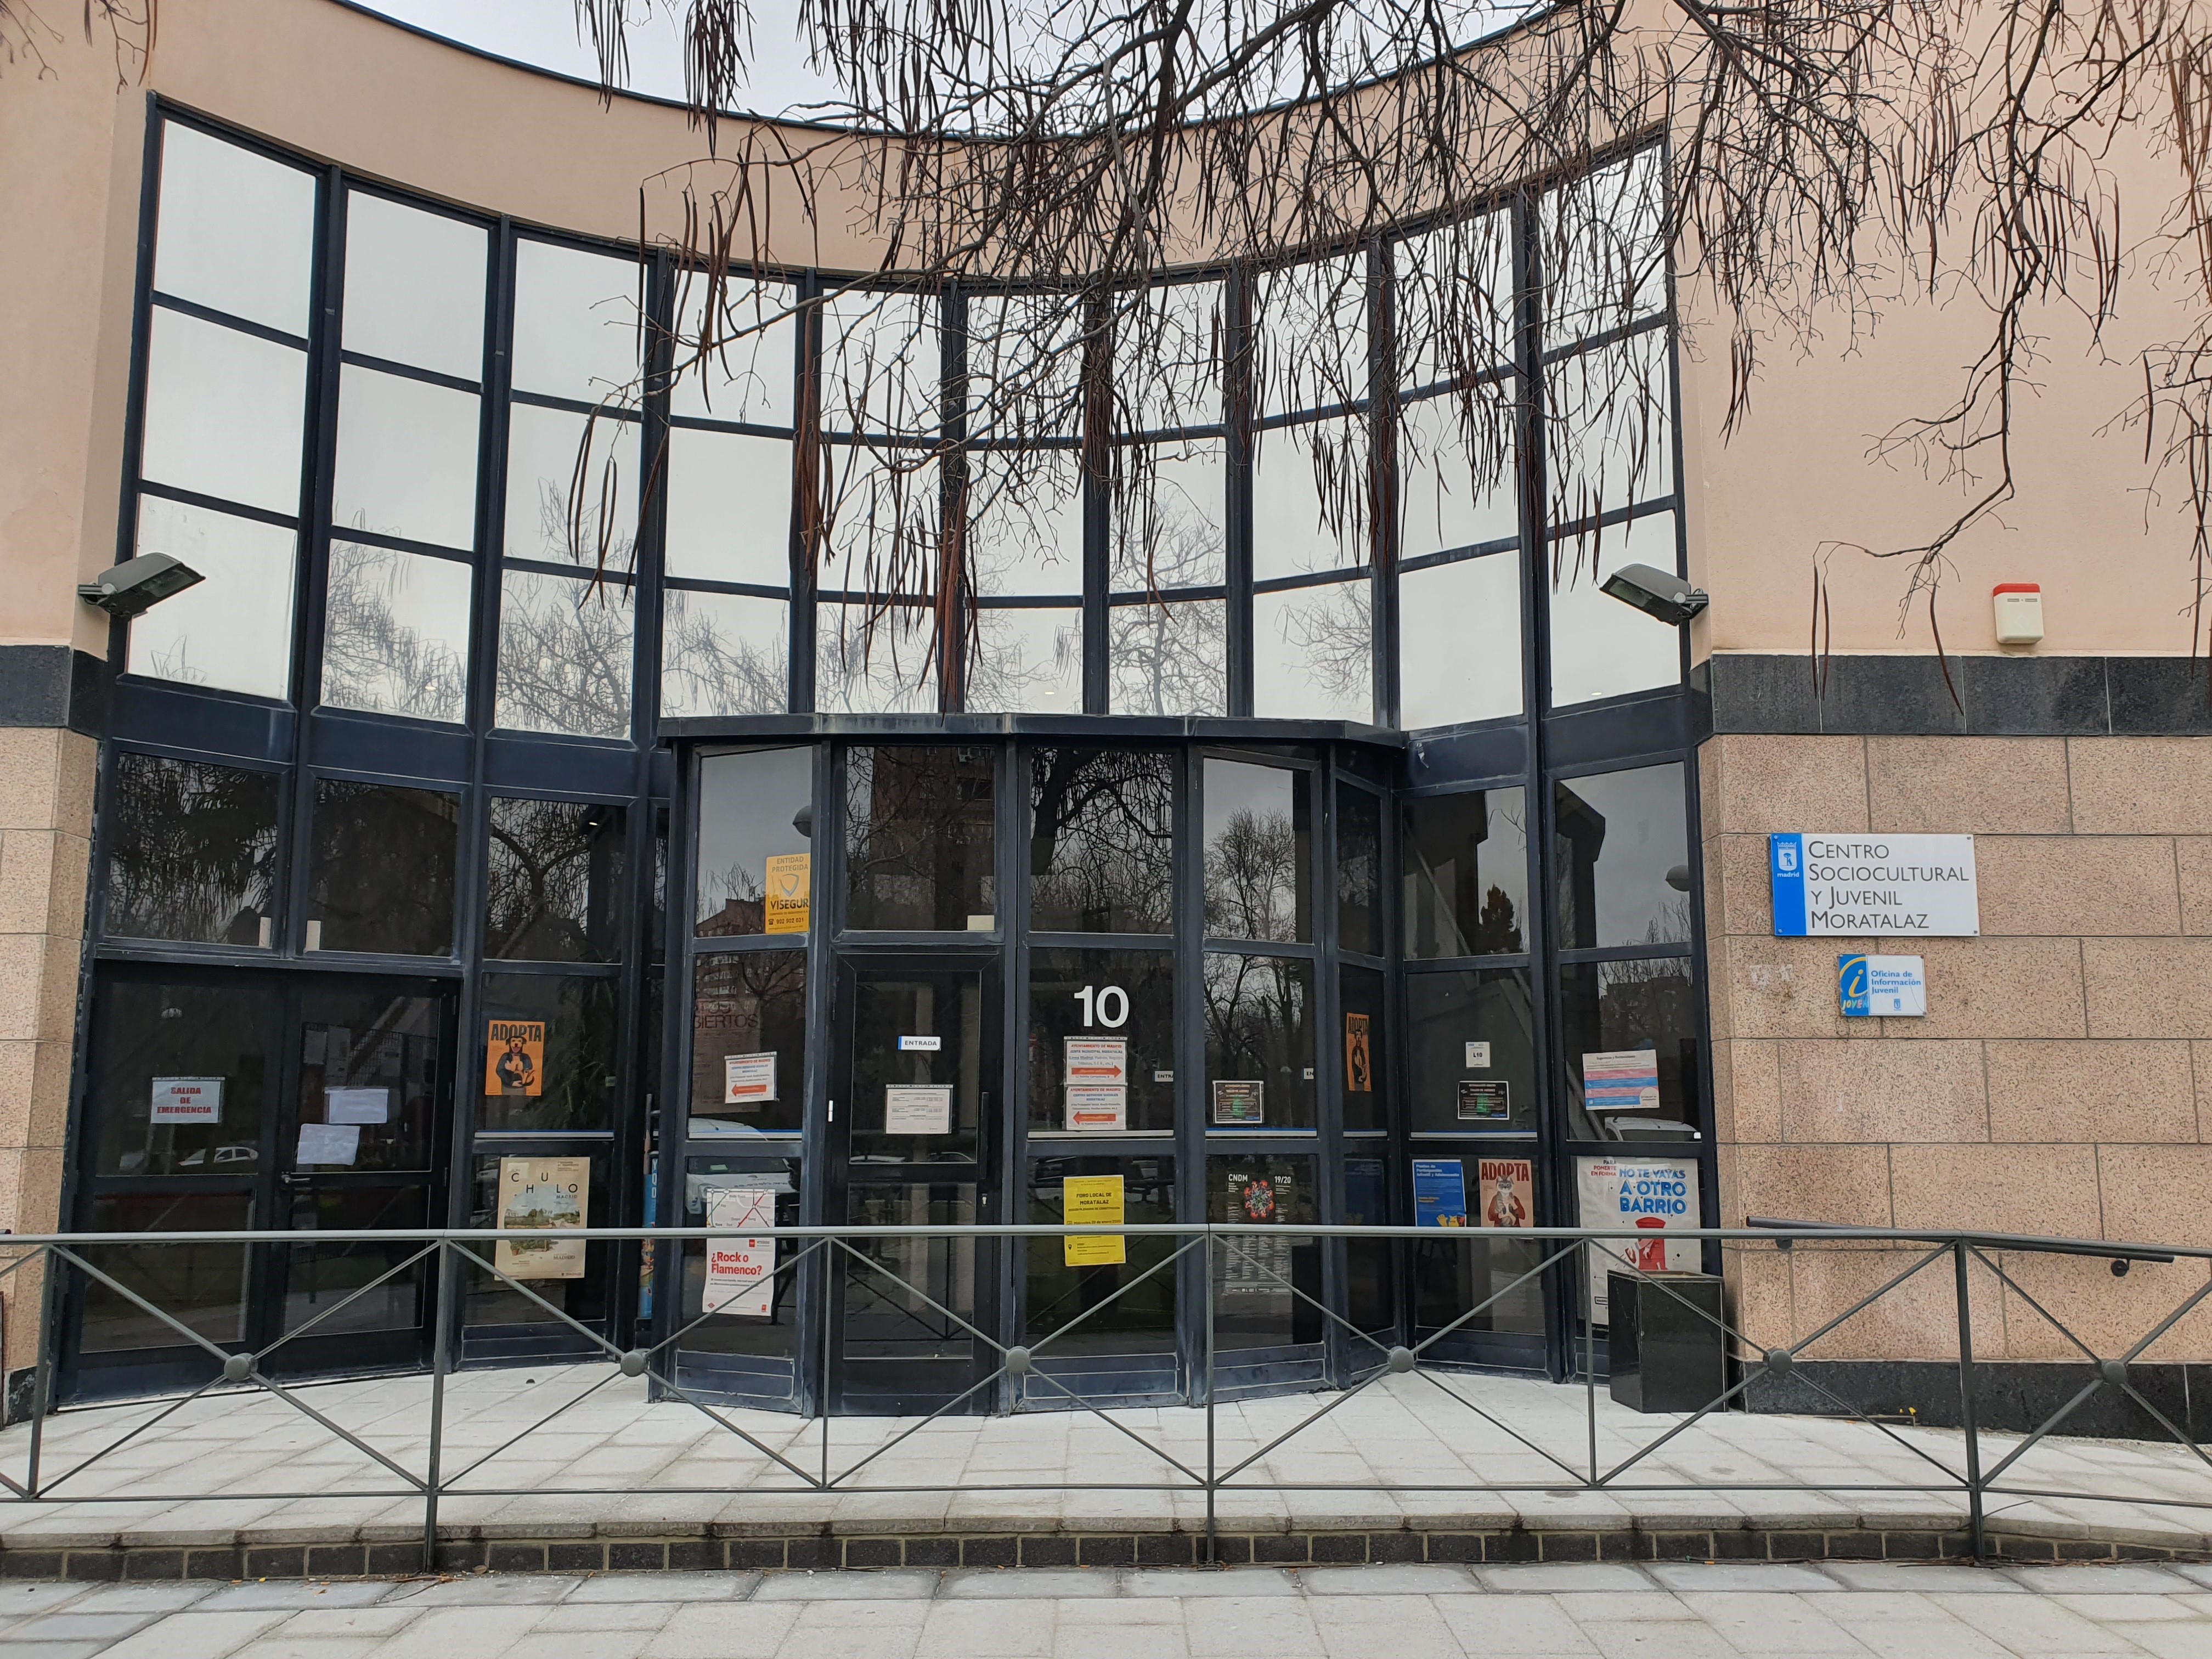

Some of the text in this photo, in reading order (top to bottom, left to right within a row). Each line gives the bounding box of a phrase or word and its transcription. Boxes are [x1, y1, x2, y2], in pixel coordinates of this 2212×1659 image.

[1808, 840, 1889, 859] CENTRO
[772, 864, 808, 872] PROTEGIDA
[1809, 863, 1970, 882] SOCIOCULTURAL
[770, 898, 809, 910] VISEGUR
[1810, 886, 1903, 910] Y JUVENIL
[1811, 911, 1929, 928] MORATALAZ
[1074, 985, 1129, 1028] 10
[490, 1024, 541, 1042] ADOPTA
[1228, 1173, 1248, 1182] CNDM
[1274, 1176, 1291, 1184] 19/20
[1481, 1162, 1530, 1181] ADOPTA
[1619, 1169, 1686, 1178] NO TE VAYAS
[1620, 1180, 1687, 1197] A OTRO
[1620, 1196, 1687, 1215] BARRIO
[711, 1251, 741, 1262] ¿Rock
[712, 1263, 762, 1276] Flamenco?
